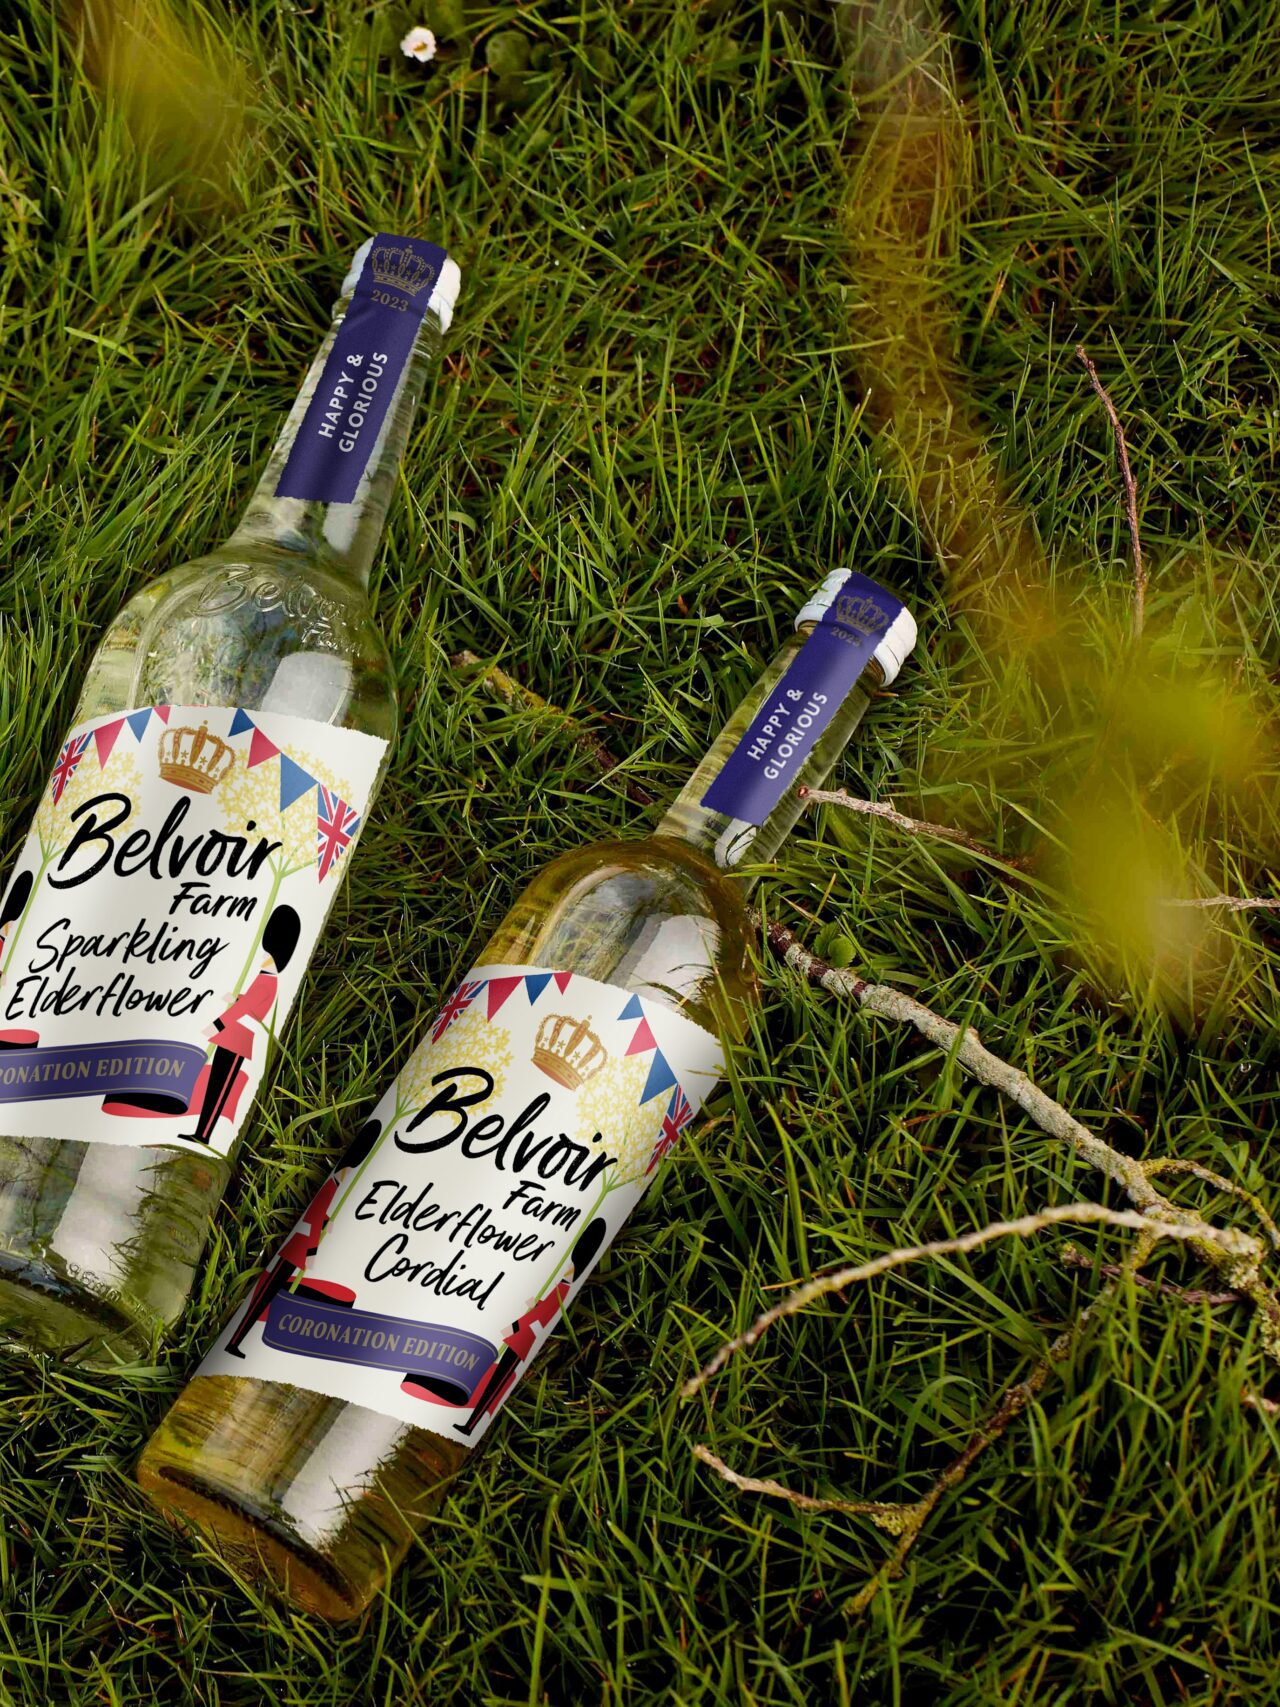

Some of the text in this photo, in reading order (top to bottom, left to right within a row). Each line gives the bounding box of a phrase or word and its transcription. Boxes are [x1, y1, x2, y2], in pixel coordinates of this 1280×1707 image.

[370, 289, 410, 313] 2023
[317, 353, 364, 438] HAPPY &
[338, 352, 388, 453] GLORIOUS
[830, 625, 863, 648] 2023
[746, 688, 804, 761] HAPPY &
[763, 692, 829, 780] GLORIOUS
[46, 792, 284, 890] Belvoir
[168, 881, 258, 922] Farm
[28, 917, 231, 980] Sparkling
[5, 966, 214, 1021] Elderflower
[95, 1056, 186, 1079] EDITION
[393, 1066, 619, 1192] Belvoir
[354, 1179, 556, 1262] Elderflower
[502, 1180, 582, 1232] Farm
[363, 1233, 505, 1311] Cordial
[277, 1313, 480, 1371] CORONATION EDITION
